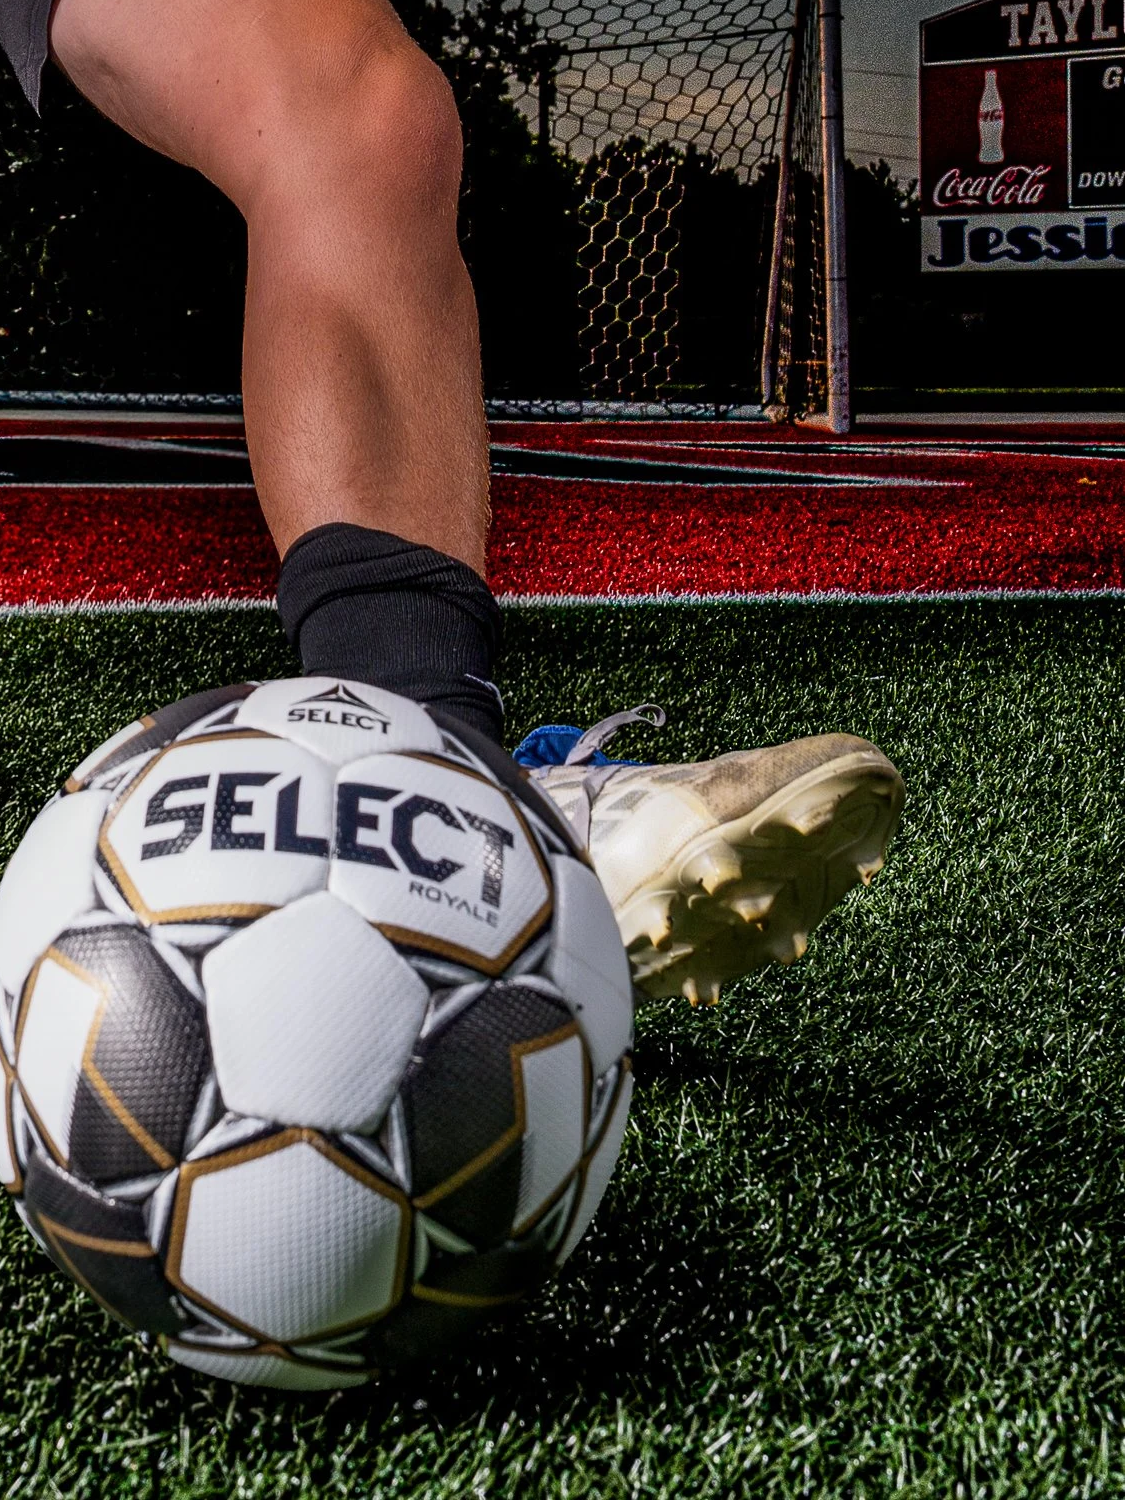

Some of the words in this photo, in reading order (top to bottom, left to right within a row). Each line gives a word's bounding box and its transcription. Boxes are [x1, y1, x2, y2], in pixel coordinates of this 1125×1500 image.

[932, 163, 1052, 207] Coca-Cola
[286, 707, 392, 736] SELECT
[140, 771, 515, 910] SELECT
[407, 879, 500, 929] ROYALE
